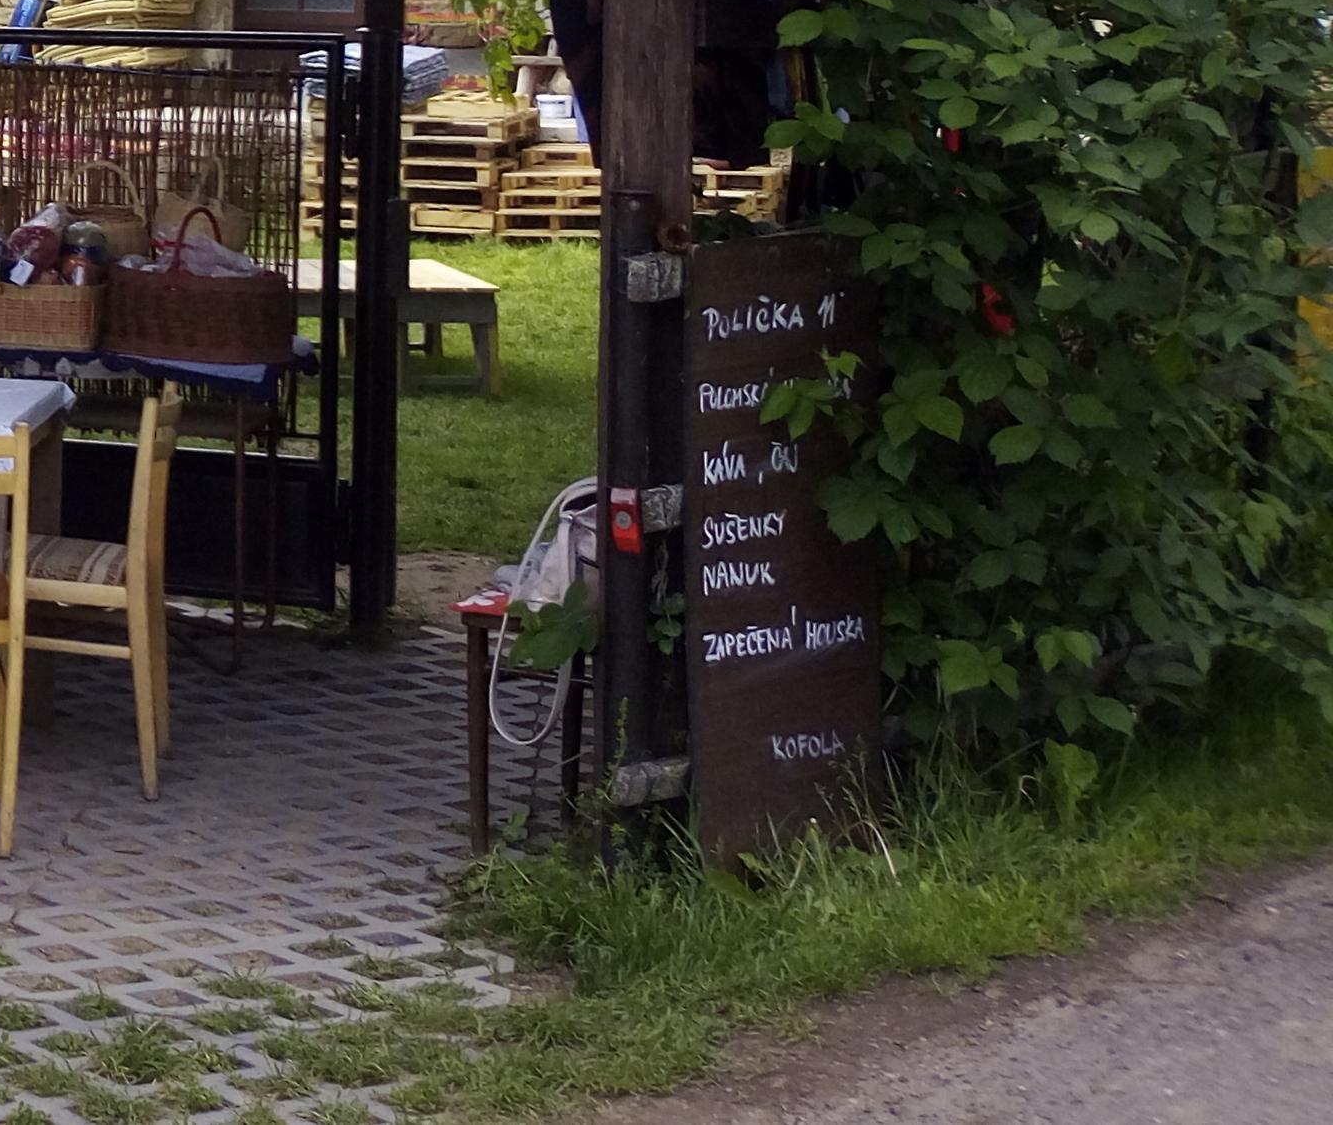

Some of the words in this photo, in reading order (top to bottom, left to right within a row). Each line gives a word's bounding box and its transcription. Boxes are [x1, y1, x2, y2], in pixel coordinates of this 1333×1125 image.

[701, 293, 805, 342] POLIČKA
[701, 509, 788, 550] SUŠENKY
[702, 560, 776, 596] NANUK
[701, 604, 797, 663] ZAPEČENÁ
[805, 613, 866, 651] HOUSKA
[771, 731, 846, 762] KOFOLA
